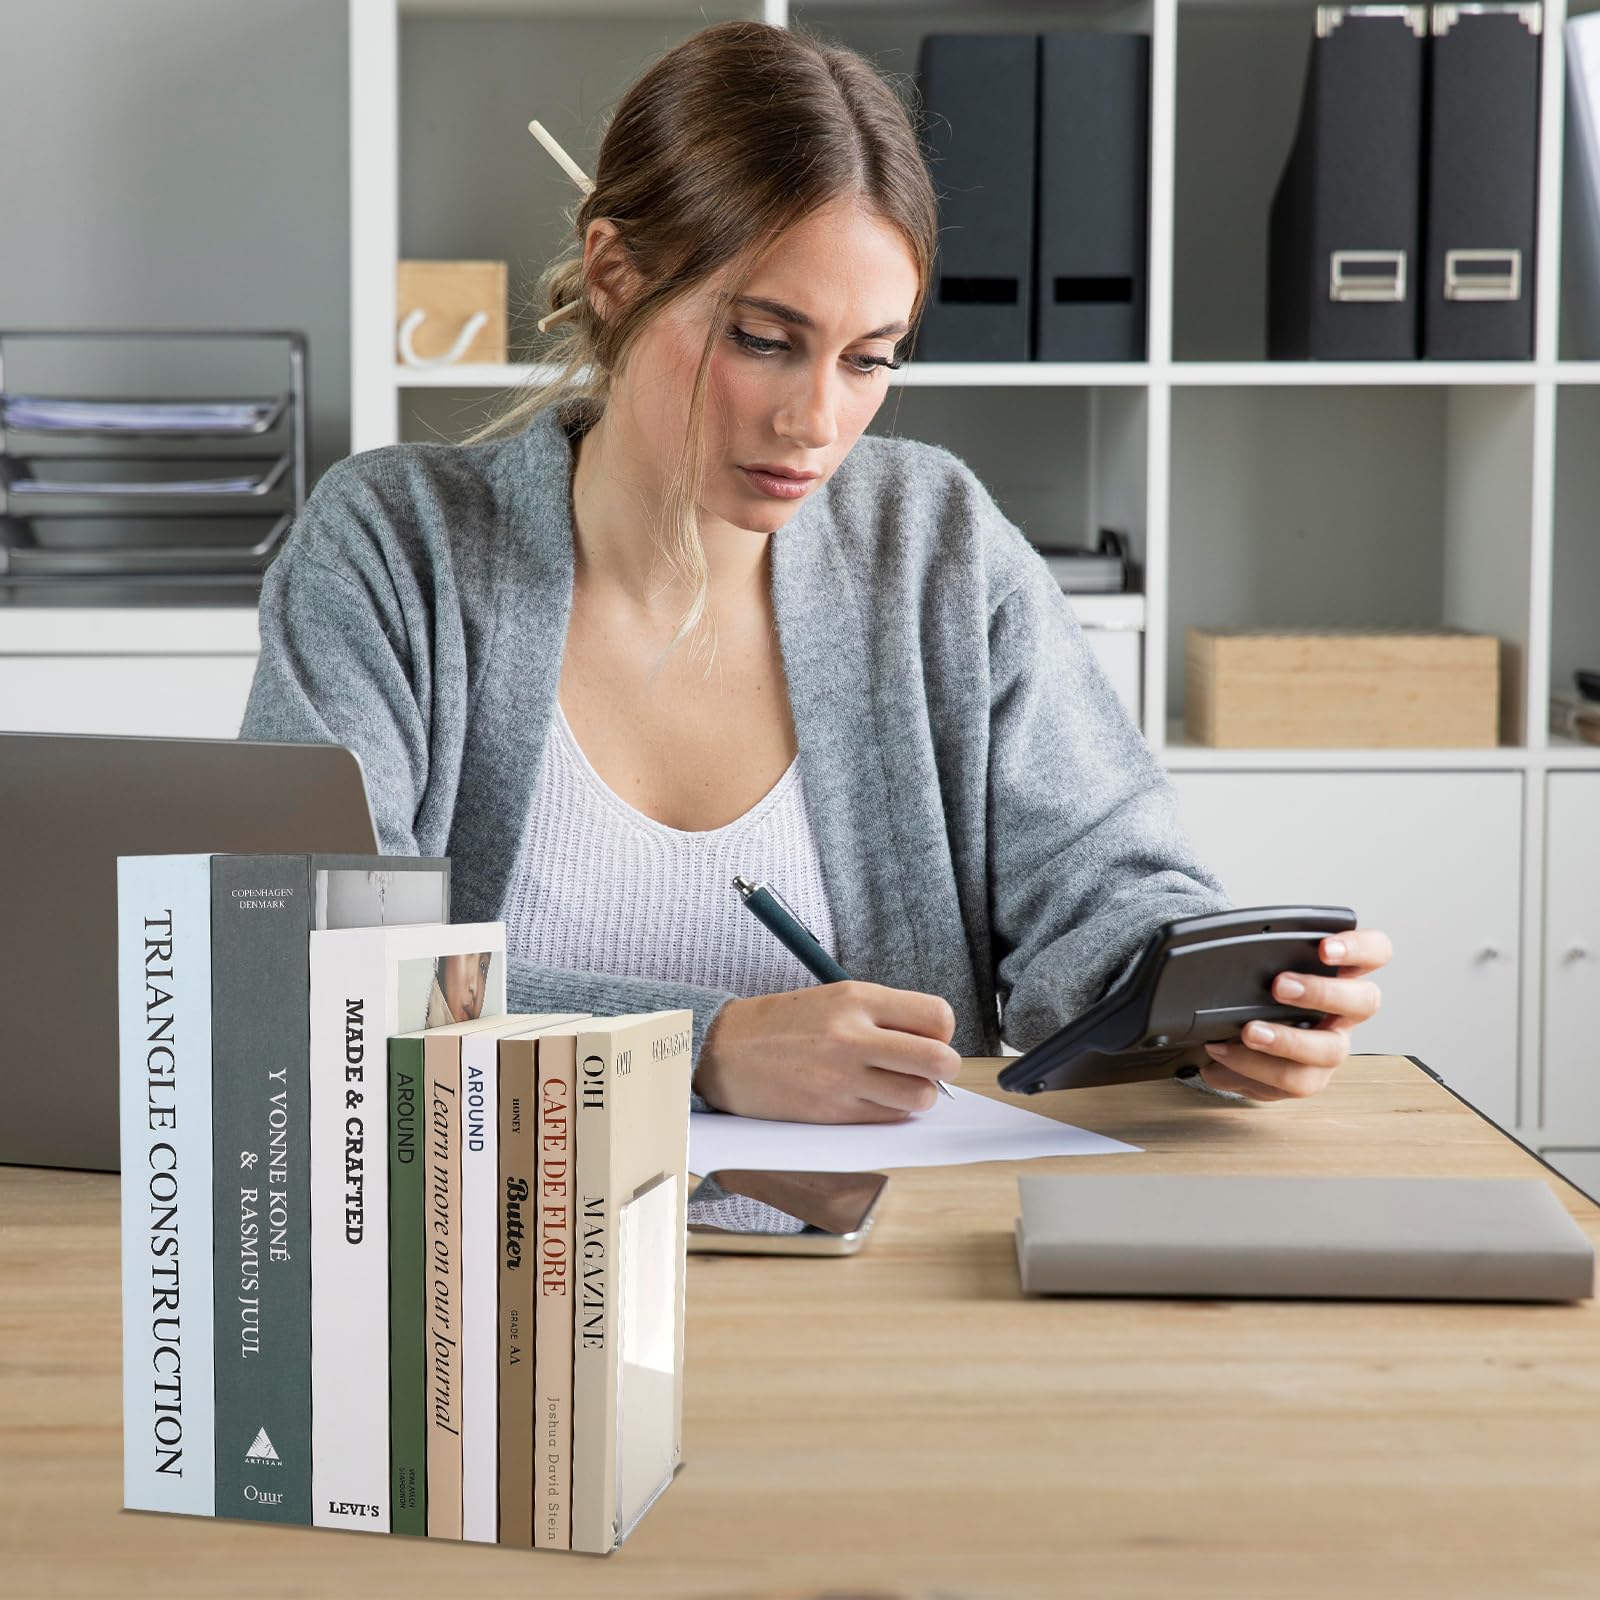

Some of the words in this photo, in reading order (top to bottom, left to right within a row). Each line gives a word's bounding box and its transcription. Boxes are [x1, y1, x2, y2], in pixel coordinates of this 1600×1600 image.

[232, 889, 292, 897] COPENHAGEN
[145, 910, 176, 1130] TRIANGLE
[346, 999, 363, 1082] MADE
[346, 1090, 363, 1109] &
[468, 1066, 483, 1151] AROUND
[583, 1056, 604, 1109] O!H
[397, 1073, 414, 1163] AROUND
[434, 1080, 454, 1159] Learn
[511, 1098, 521, 1134] HONEY
[543, 1079, 567, 1151] CAFE
[241, 1152, 258, 1170] &
[346, 1118, 363, 1244] CRAFTED
[544, 1159, 566, 1197] DE
[270, 1190, 290, 1261] KONÉ
[434, 1166, 448, 1235] more
[507, 1177, 528, 1270] Butter
[241, 1187, 258, 1290] RASMUS
[435, 1241, 449, 1274] on
[543, 1206, 566, 1296] FLORE
[583, 1196, 604, 1348] MAGAZINE
[149, 1143, 182, 1477] CONSTRUCTION
[239, 1297, 259, 1358] JUUL
[434, 1280, 450, 1330] our
[510, 1310, 518, 1339] GRADE
[432, 1327, 459, 1435] Journal
[547, 1398, 560, 1447] Joshua
[245, 1458, 283, 1466] ARTISAN
[548, 1454, 559, 1496] David
[244, 1486, 283, 1504] Ouur
[329, 1502, 379, 1517] LEVI'S
[548, 1503, 559, 1540] Stein
